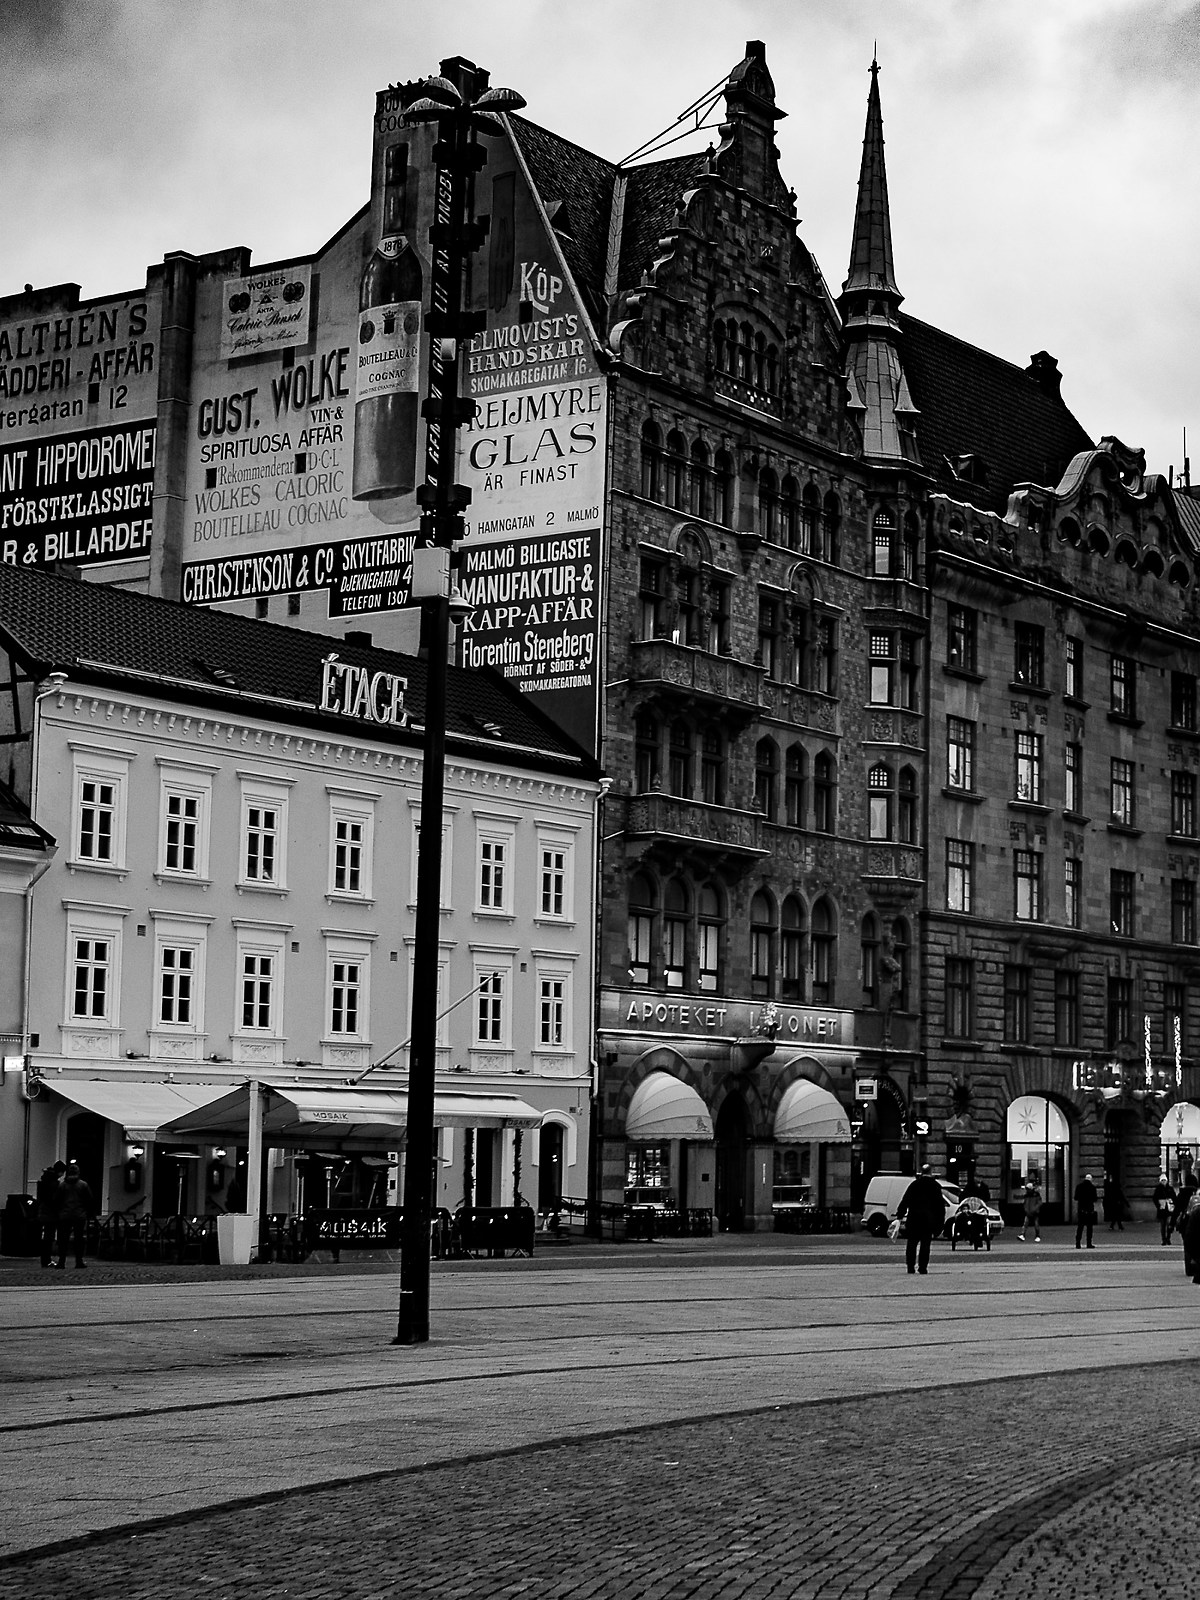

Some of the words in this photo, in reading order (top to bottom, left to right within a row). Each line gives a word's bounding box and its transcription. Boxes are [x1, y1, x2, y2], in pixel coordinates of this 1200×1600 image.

[248, 277, 286, 291] WOLKES
[469, 313, 578, 353] ELMQVIST'S
[89, 341, 154, 383] AFFÄR
[359, 349, 405, 368] BOUTELLEAU
[468, 338, 584, 374] HANDSKAR
[199, 387, 260, 438] GUST.
[271, 347, 350, 420] WOLKE
[369, 369, 406, 383] COGNAC
[471, 362, 568, 393] SKOMAKAREGATAN
[109, 385, 128, 409] 12
[467, 385, 602, 432] REIJMYRE
[200, 433, 292, 463] SPIRITUOSA
[298, 423, 343, 448] AFFÄR
[469, 422, 597, 470] GLAS
[218, 456, 294, 485] Rekommenderar
[484, 472, 503, 491] ÄR
[520, 463, 579, 486] FINAST
[1, 482, 154, 528] FÖRSTKLASSIGT
[195, 484, 261, 514] WOLKES
[276, 470, 344, 501] CALORIC
[193, 508, 281, 543] BOUTELLEAU
[288, 497, 348, 527] COGNAC
[478, 515, 535, 535] HAMNGATAN
[546, 511, 555, 526] 2
[567, 506, 599, 522] MALMÖ
[22, 543, 39, 564] &
[342, 536, 417, 571] SKYLTFABRIK
[467, 544, 515, 573] MALMÖ
[520, 537, 591, 566] BILLIGASTE
[183, 553, 294, 602] CHRISTENSON
[295, 554, 309, 588] &
[340, 569, 401, 592] DJEKNEGATAN
[402, 564, 413, 584] 4
[342, 594, 382, 611] TELEFON
[387, 589, 409, 606] 1307
[463, 596, 594, 633] KAPP-AFFÄR
[463, 636, 520, 668] Florentin
[524, 628, 594, 664] Steneberg
[504, 662, 533, 678] HÖRNET
[536, 662, 546, 675] AF
[519, 674, 592, 693] SKOMAKAREGATORNA
[319, 652, 408, 727] ÉTAGE
[627, 1001, 727, 1027] APOTEKET
[750, 1011, 837, 1036] LJONET
[313, 1112, 349, 1120] MOSAIK
